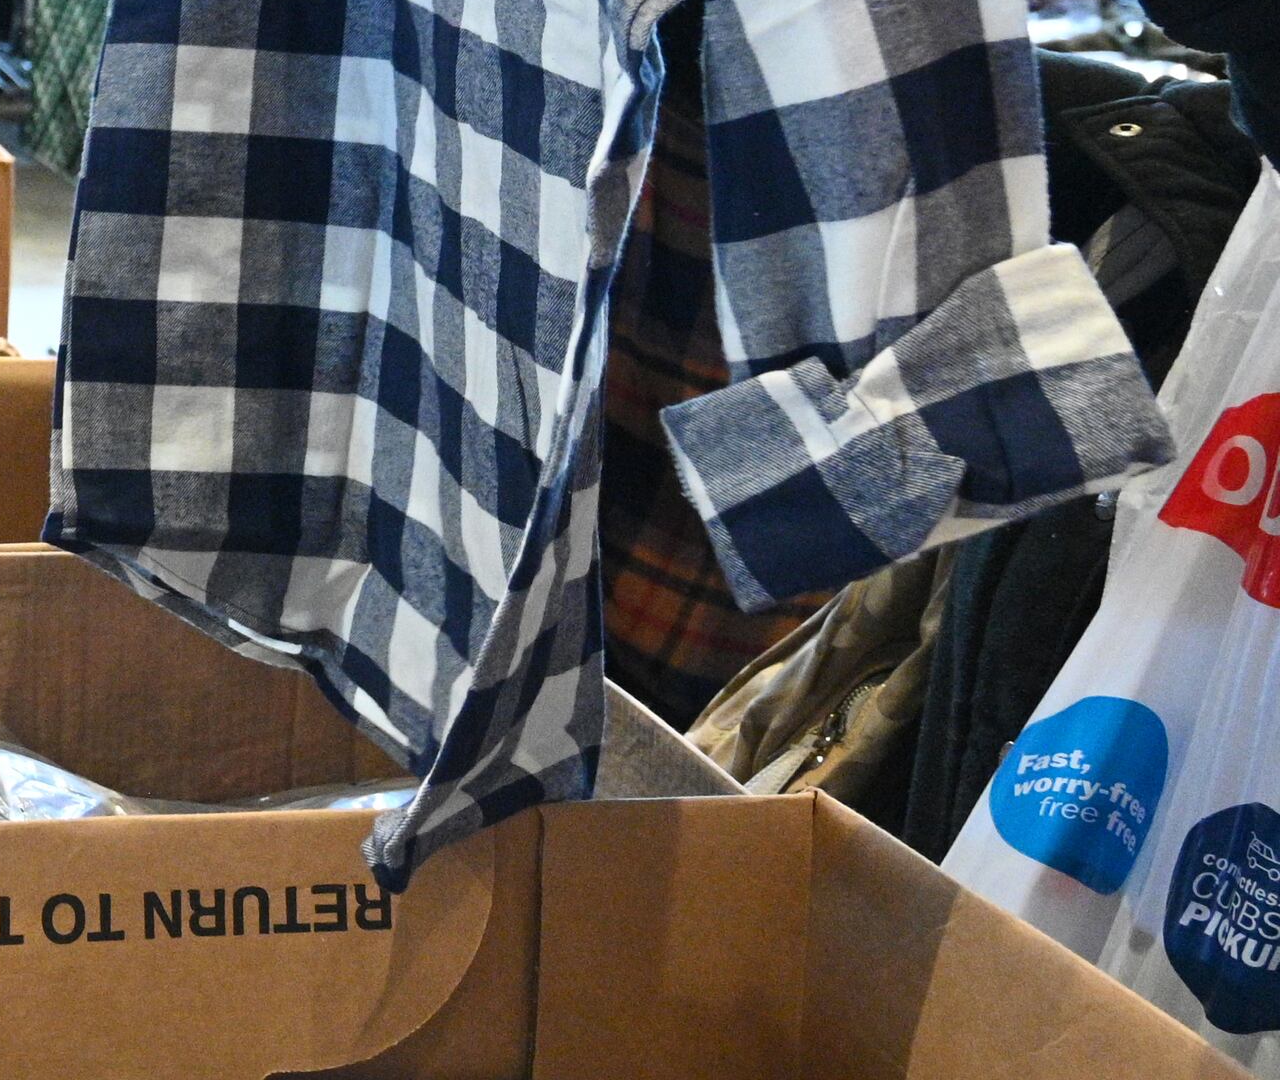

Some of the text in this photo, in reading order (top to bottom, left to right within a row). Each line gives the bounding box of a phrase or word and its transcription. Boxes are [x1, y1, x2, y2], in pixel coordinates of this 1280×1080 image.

[1016, 749, 1092, 775] Fast,
[1014, 777, 1146, 825] worry-free
[1039, 796, 1099, 823] free
[41, 892, 126, 946] TO
[144, 883, 394, 941] RETURN
